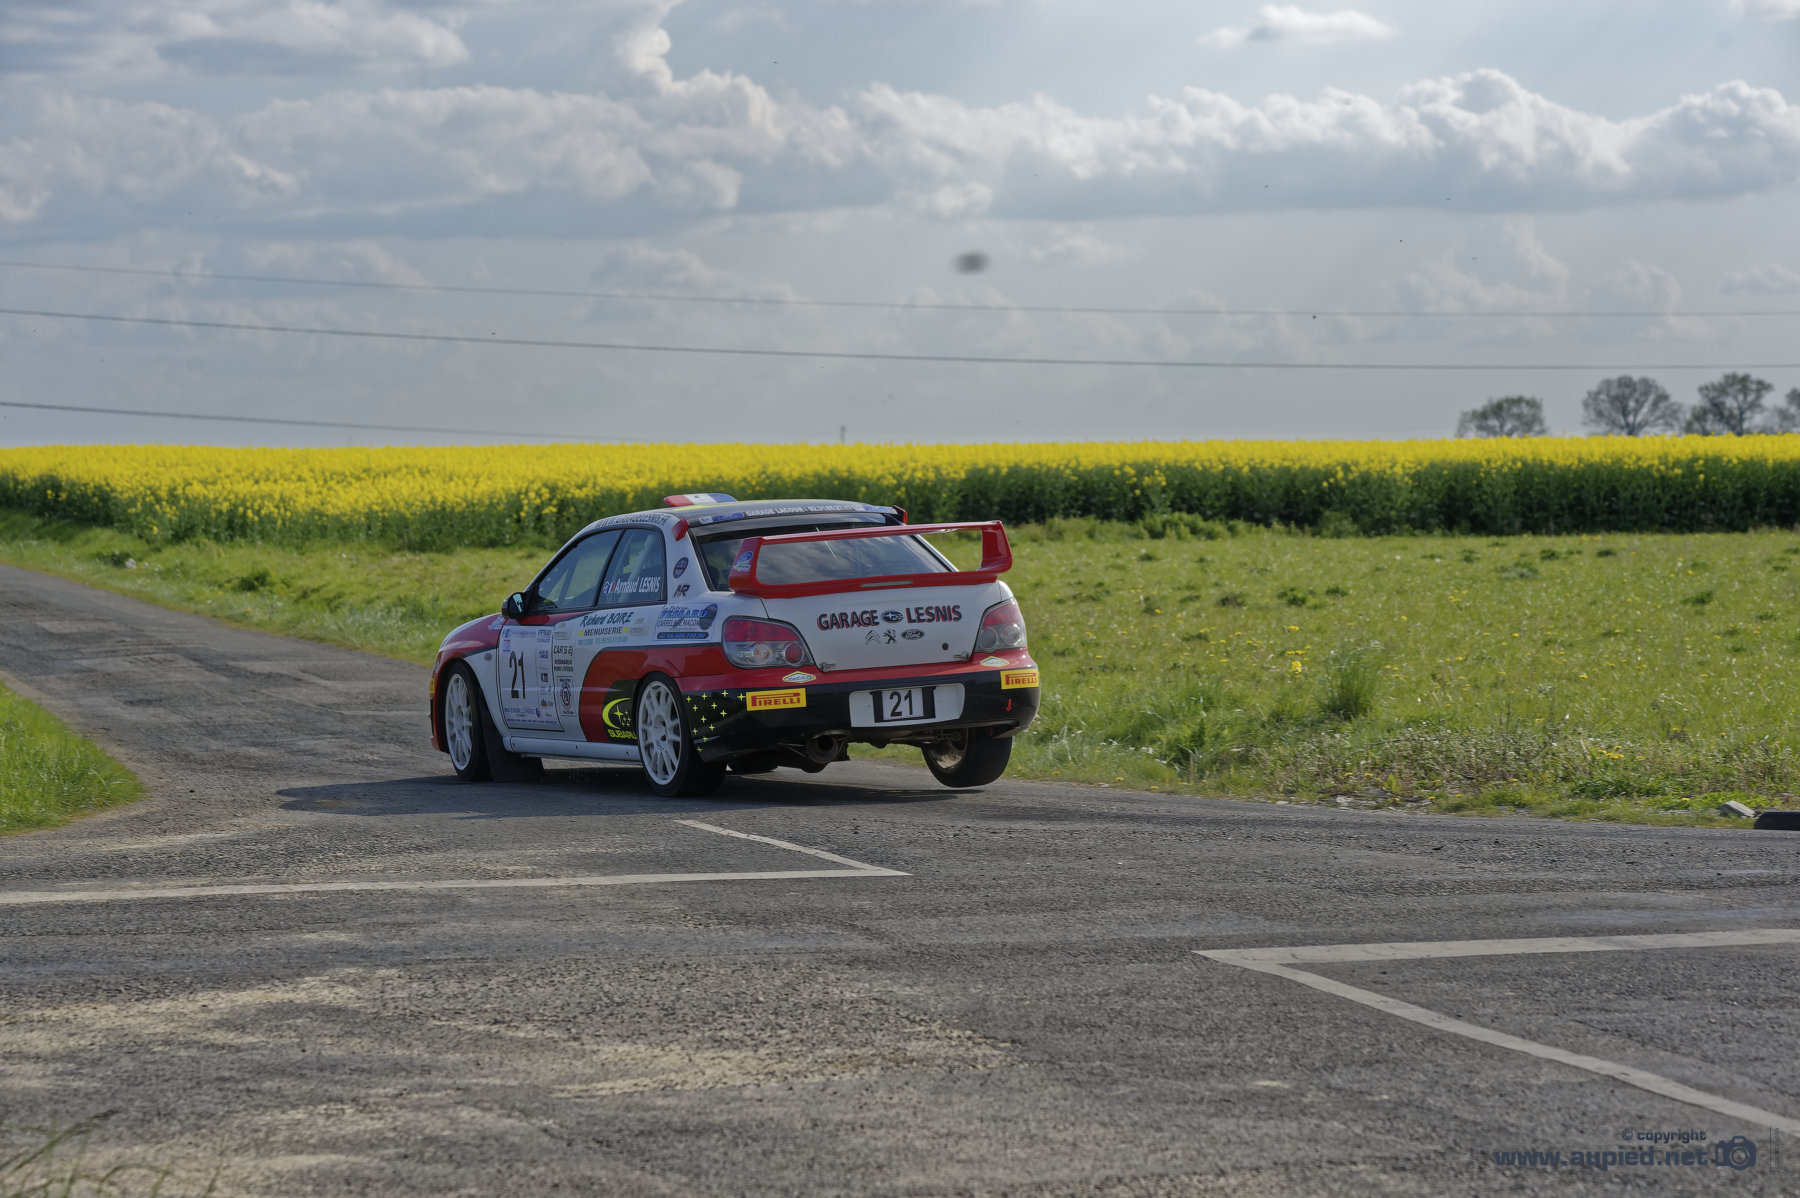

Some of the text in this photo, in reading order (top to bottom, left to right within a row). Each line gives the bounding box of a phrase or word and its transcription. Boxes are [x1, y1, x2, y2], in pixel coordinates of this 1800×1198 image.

[817, 604, 962, 631] GARAGE LESNIS
[509, 651, 525, 699] 21
[1005, 672, 1037, 686] PIRELLI
[751, 691, 801, 707] PIRELLI
[889, 689, 914, 717] 21
